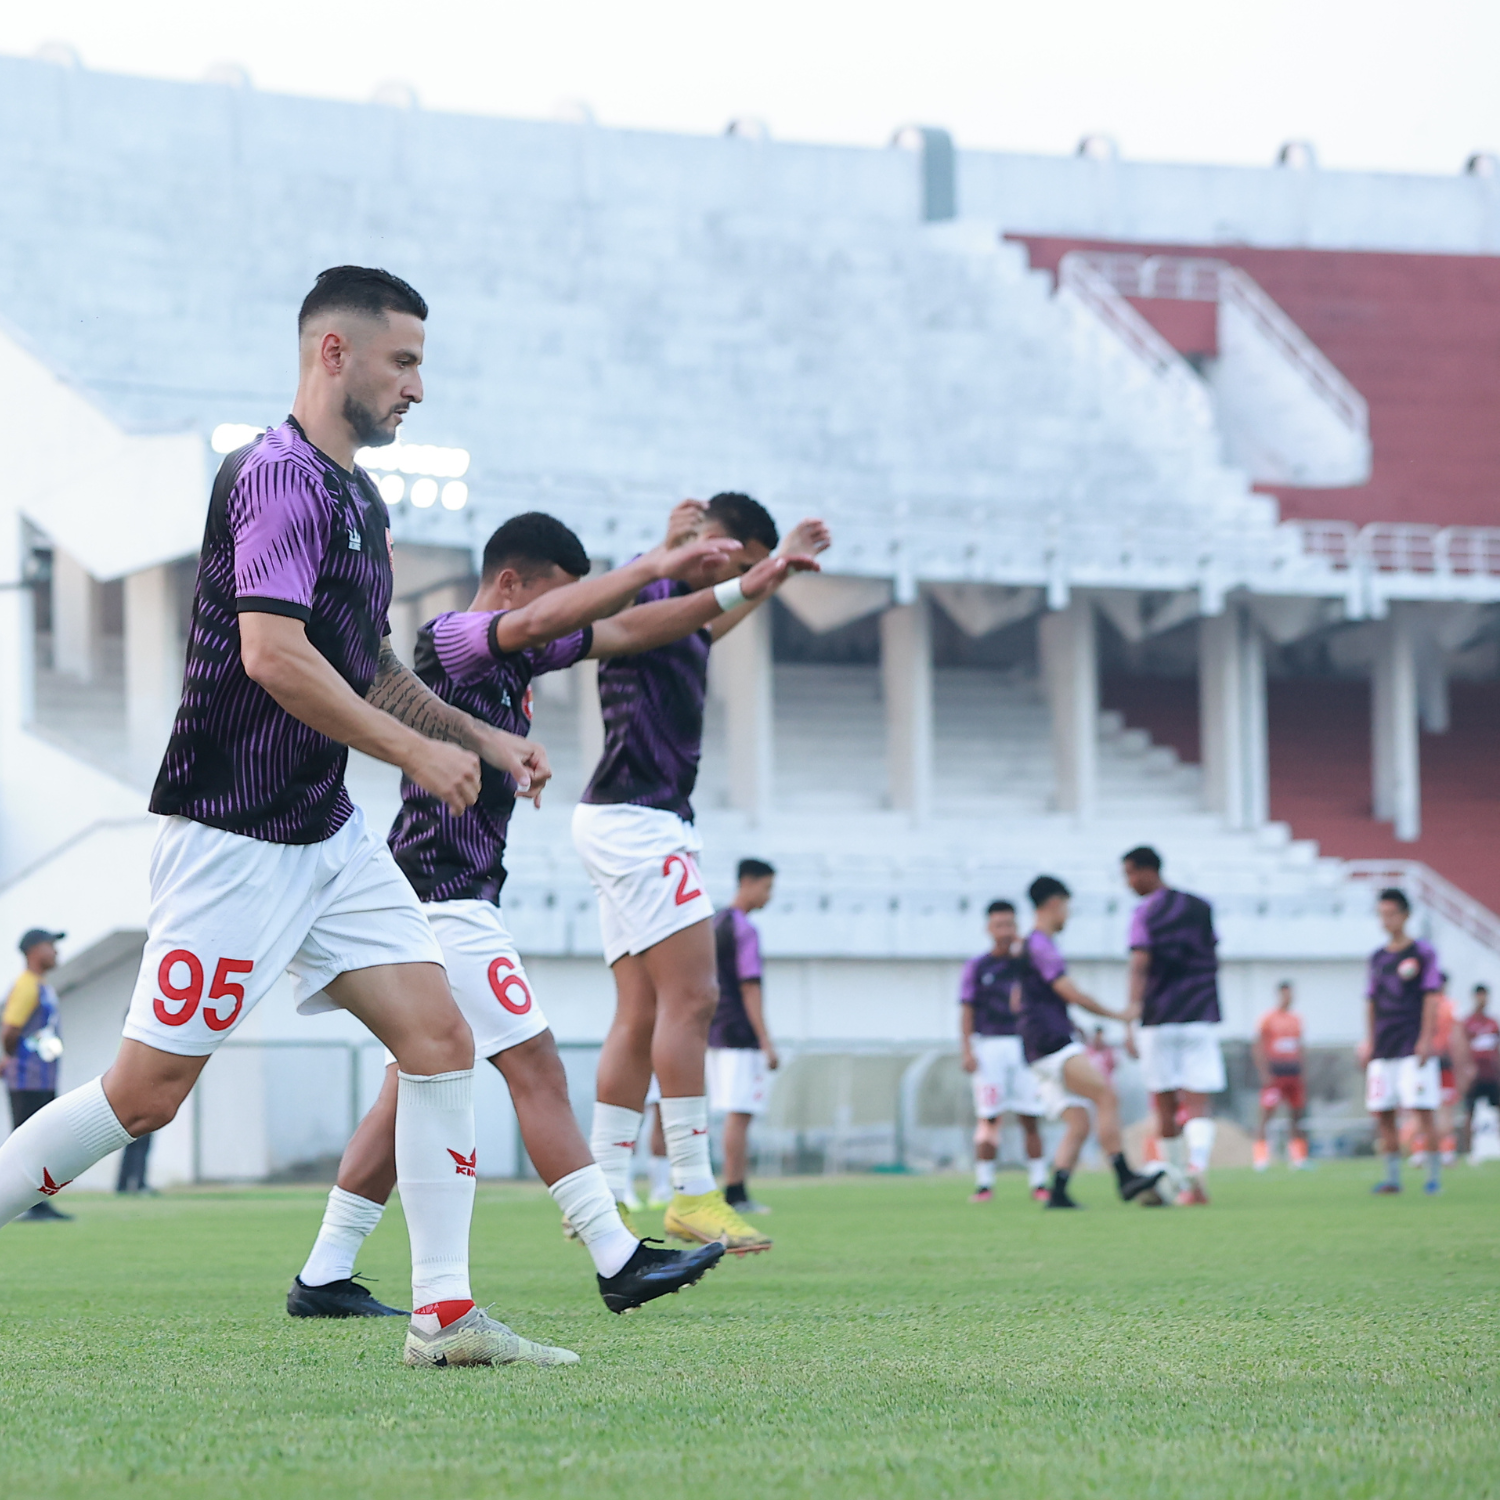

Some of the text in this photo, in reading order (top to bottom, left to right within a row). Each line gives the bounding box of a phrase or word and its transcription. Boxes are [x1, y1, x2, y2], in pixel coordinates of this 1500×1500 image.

[663, 852, 703, 906] 2
[153, 949, 254, 1032] 95
[488, 957, 531, 1015] 6
